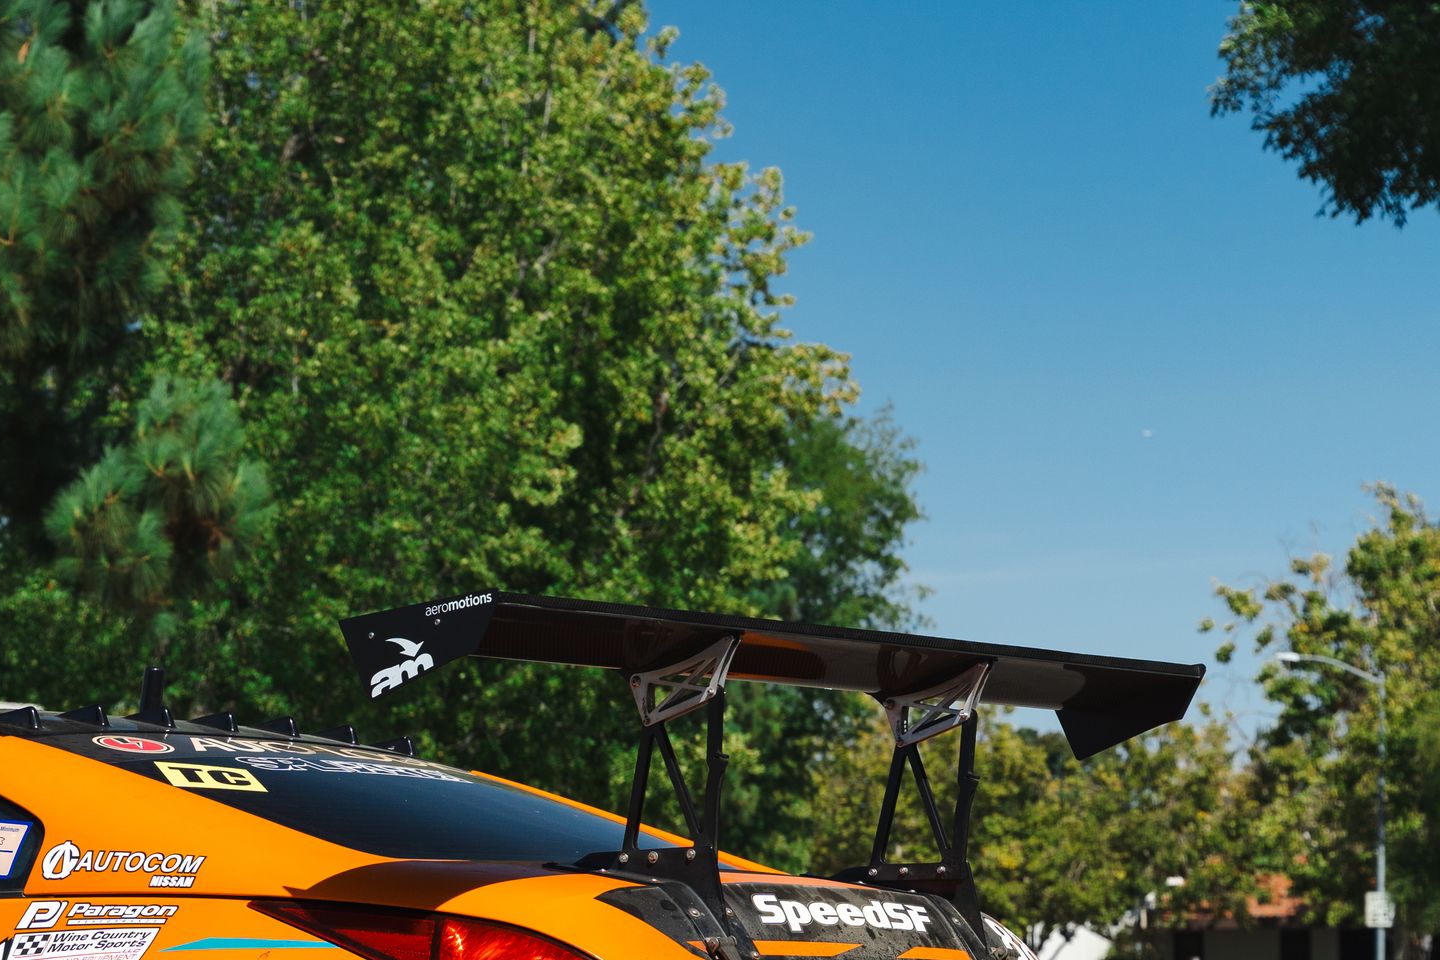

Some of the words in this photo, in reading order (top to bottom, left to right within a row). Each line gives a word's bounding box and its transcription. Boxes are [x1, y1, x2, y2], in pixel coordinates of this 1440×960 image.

[425, 592, 492, 617] aeromotions
[167, 766, 252, 786] TC
[74, 850, 208, 874] AUTOCOM
[149, 875, 197, 888] NISSAN
[66, 902, 180, 919] Paragon
[751, 893, 931, 934] SpeedSF
[53, 933, 90, 943] Wine
[91, 931, 152, 941] Country
[47, 943, 93, 953] Motor
[94, 940, 147, 950] Sports
